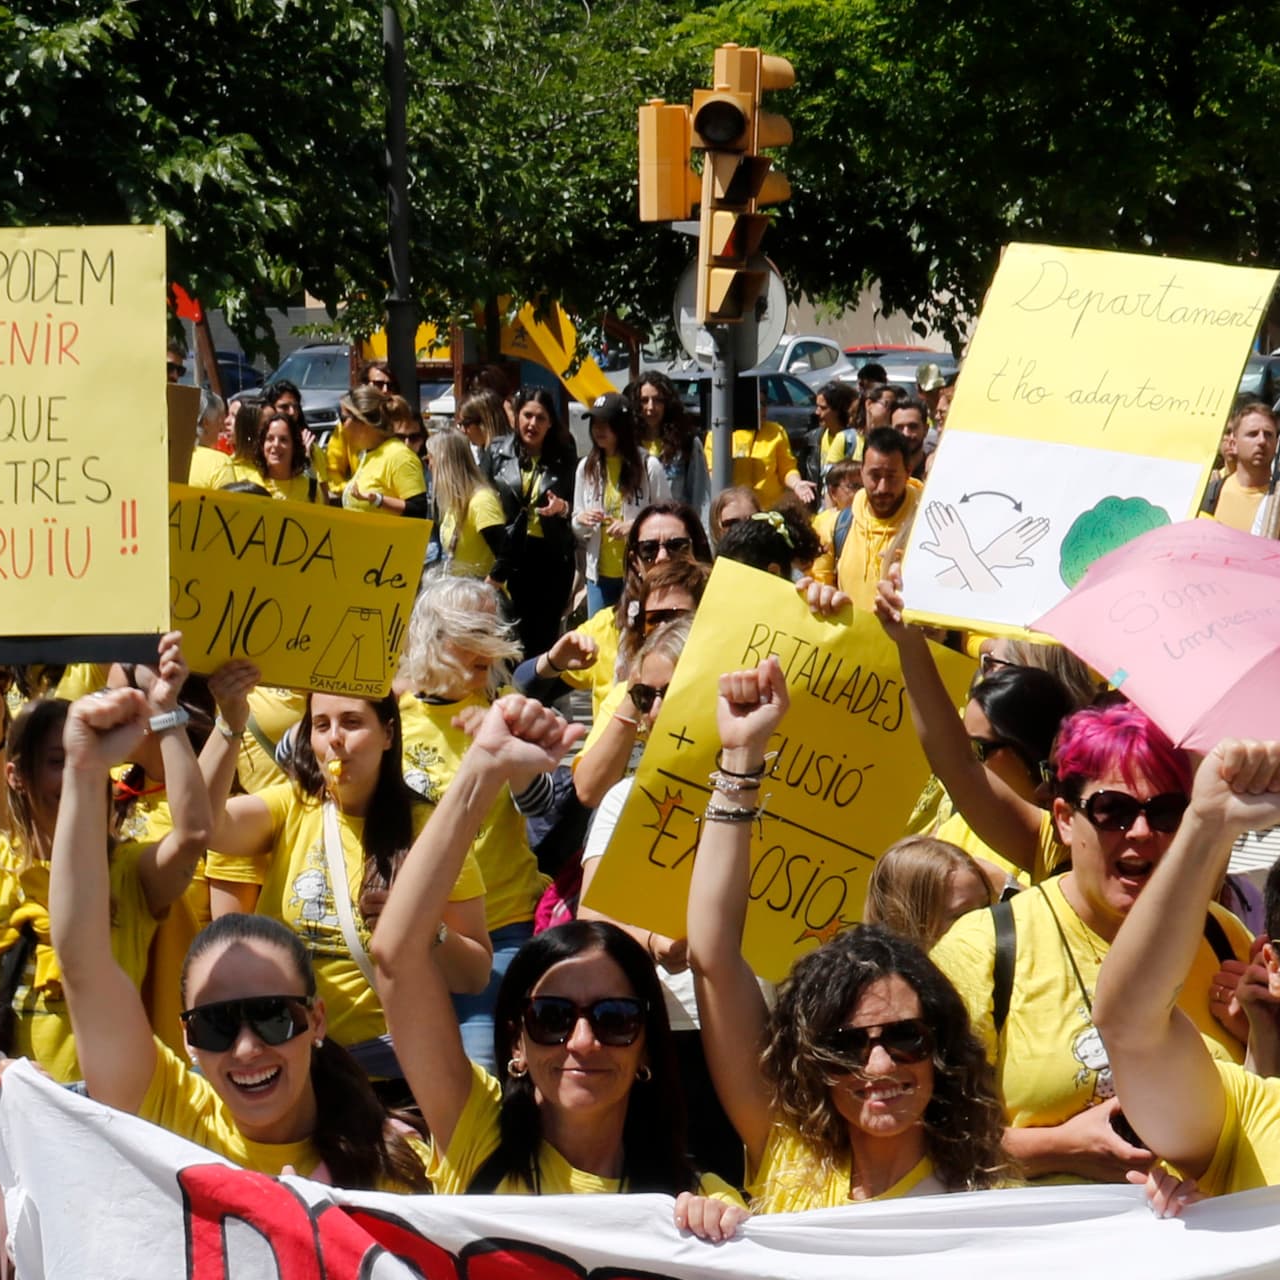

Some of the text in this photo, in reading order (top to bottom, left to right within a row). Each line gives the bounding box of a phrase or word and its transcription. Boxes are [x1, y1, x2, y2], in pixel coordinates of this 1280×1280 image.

[1011, 260, 1269, 338] Departament
[986, 356, 1052, 405] t'ho
[168, 495, 408, 589] AIXADA de
[206, 586, 284, 658] NO
[285, 604, 313, 652] de
[309, 675, 384, 695] PANTALONS
